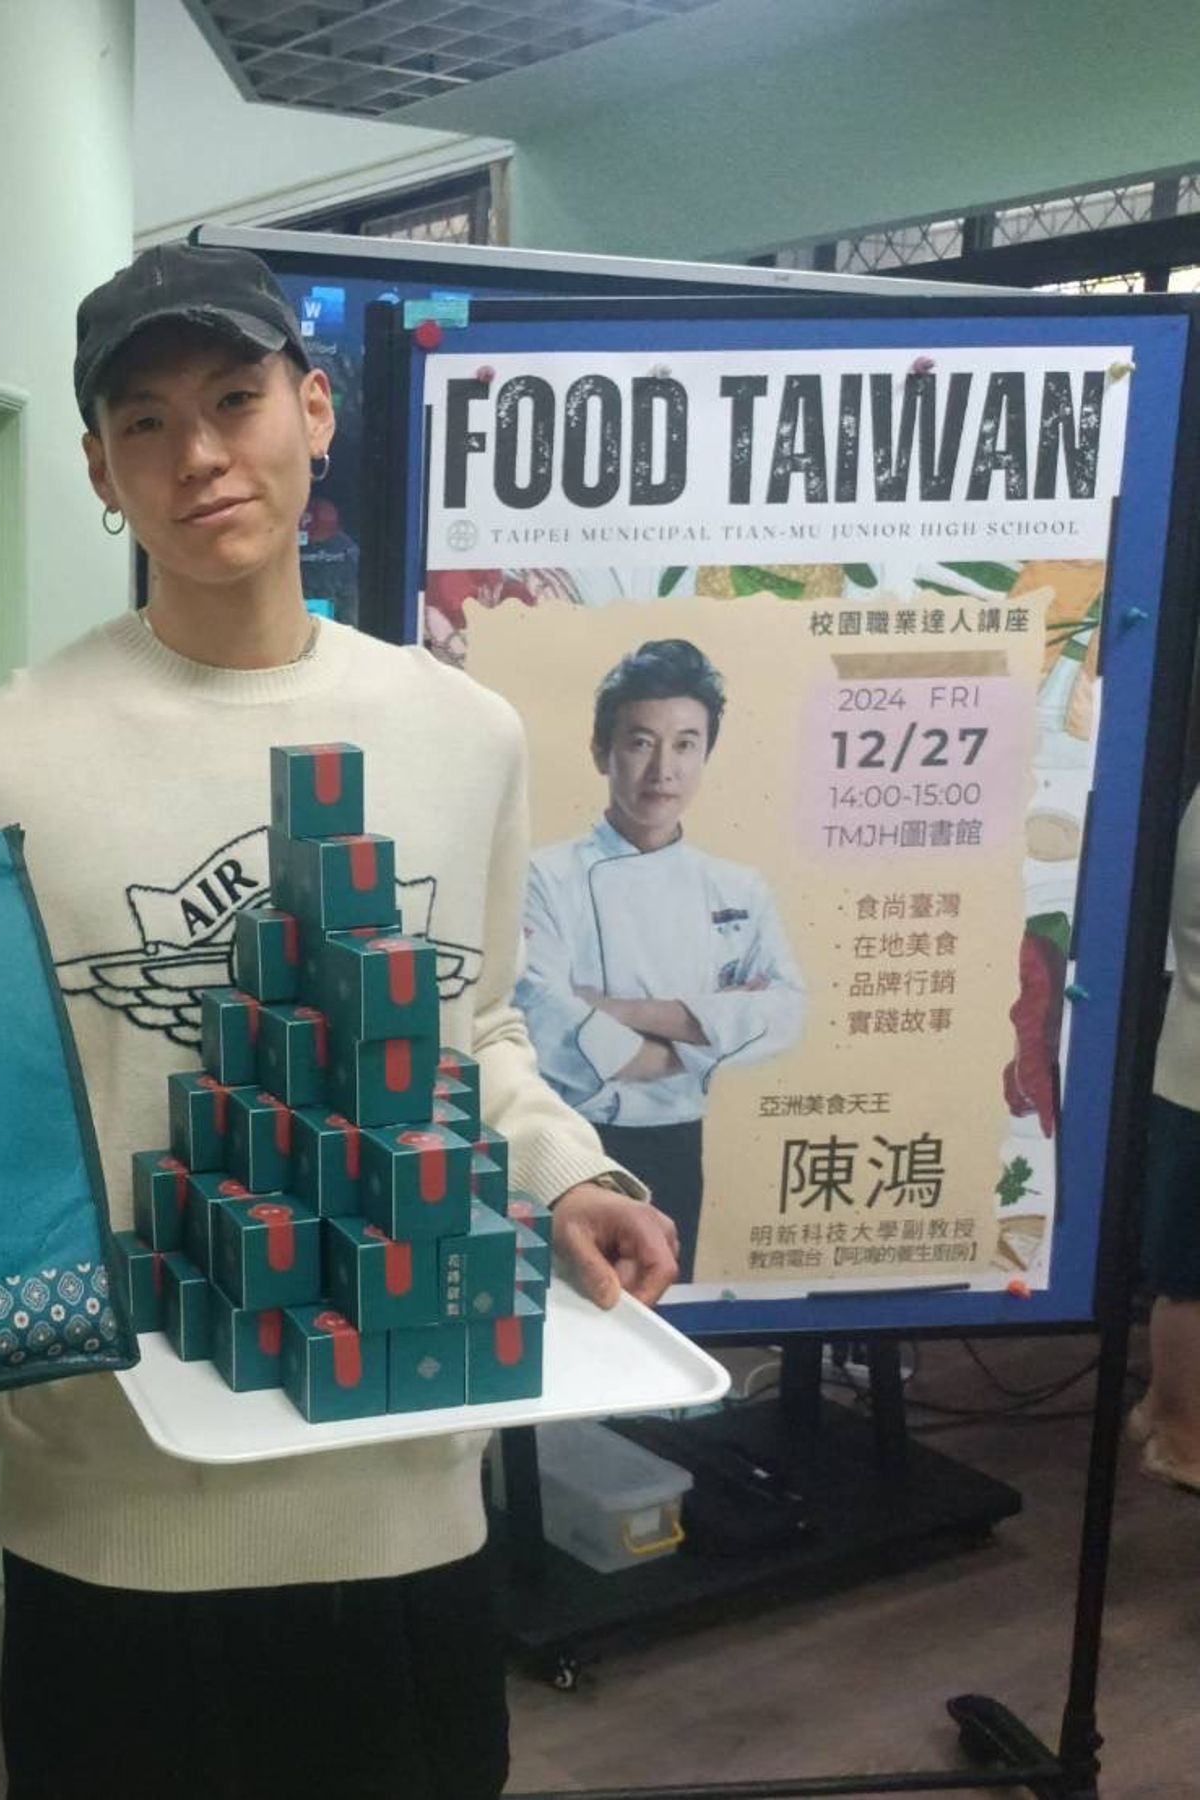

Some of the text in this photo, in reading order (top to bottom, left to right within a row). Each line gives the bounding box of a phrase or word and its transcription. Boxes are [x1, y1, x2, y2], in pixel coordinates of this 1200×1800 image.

[444, 371, 1105, 509] FOOD TAIWAN
[490, 519, 1080, 544] TAIPEI MUNICIPAL TIAN-MU JUNIOR HIGH SCHOOL
[810, 608, 1030, 637] 校園職業達人講座
[838, 686, 980, 712] 2024 FRI
[831, 721, 989, 773] 12/27
[829, 782, 982, 809] 14:00-15:00
[822, 819, 983, 848] TMJH圖書館
[181, 859, 259, 938] AIR
[758, 1092, 891, 1117] 亞洲美食天王
[779, 1131, 945, 1214] 陳鴻
[750, 1217, 976, 1246] 明新科技大學副教授
